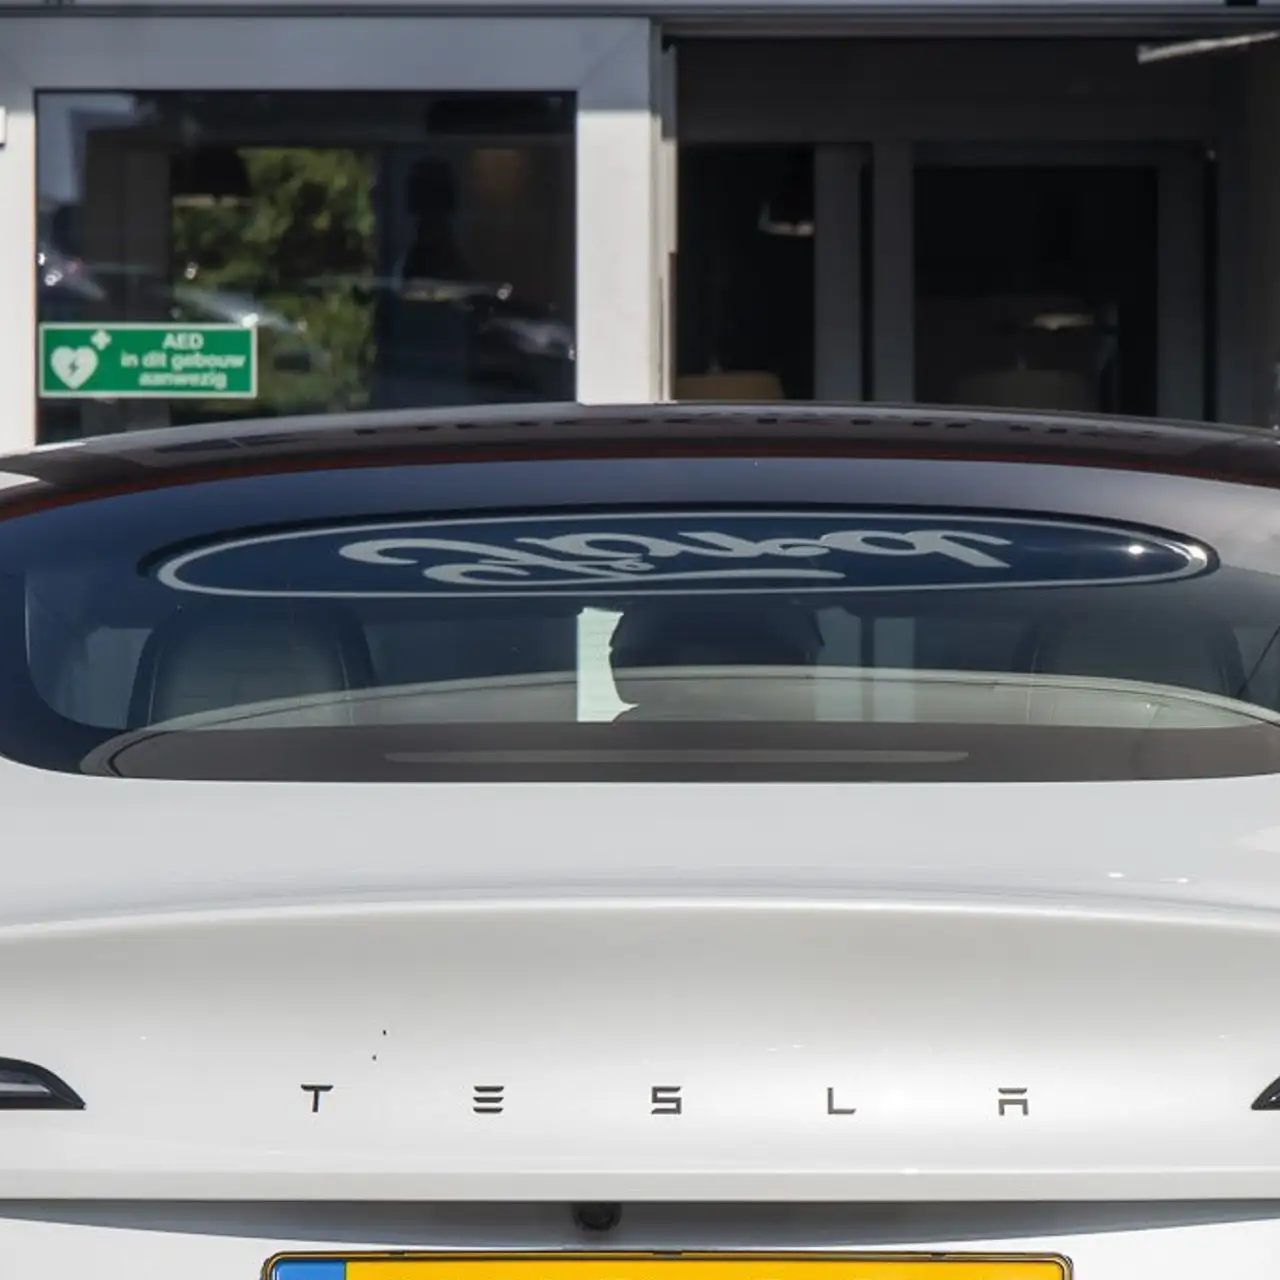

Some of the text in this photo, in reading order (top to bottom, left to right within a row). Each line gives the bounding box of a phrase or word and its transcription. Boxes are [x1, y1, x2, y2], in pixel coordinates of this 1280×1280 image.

[162, 333, 204, 350] AED
[142, 350, 167, 368] dit
[171, 352, 246, 371] gebouw
[138, 371, 227, 390] aanwezig
[301, 1084, 1029, 1116] TESLA
